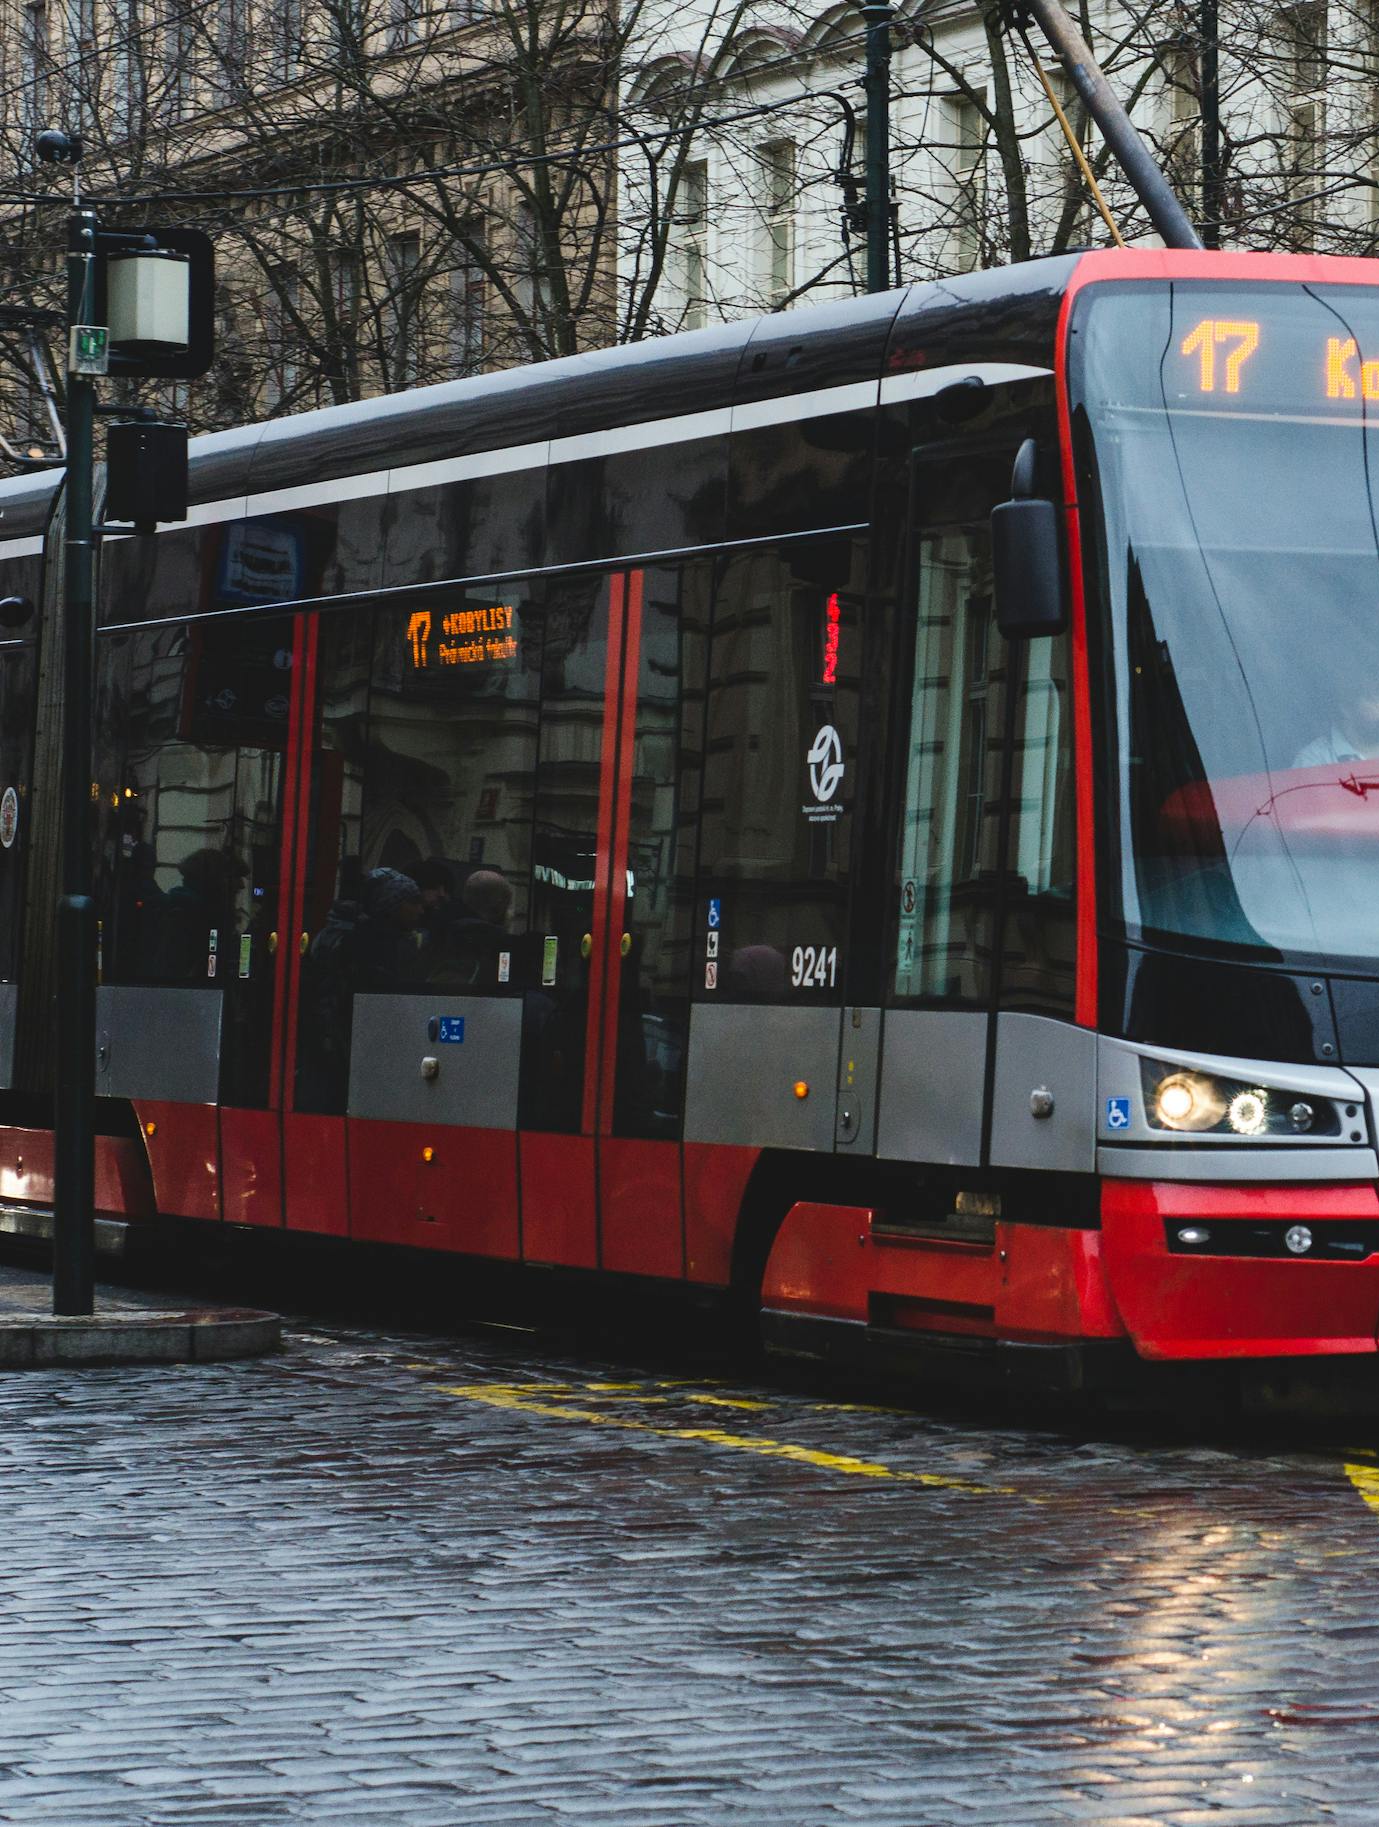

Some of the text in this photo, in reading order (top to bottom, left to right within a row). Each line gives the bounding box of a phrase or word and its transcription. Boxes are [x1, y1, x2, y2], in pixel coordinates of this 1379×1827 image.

[1182, 320, 1259, 393] 17
[407, 611, 431, 668] 17
[791, 946, 837, 987] 9241
